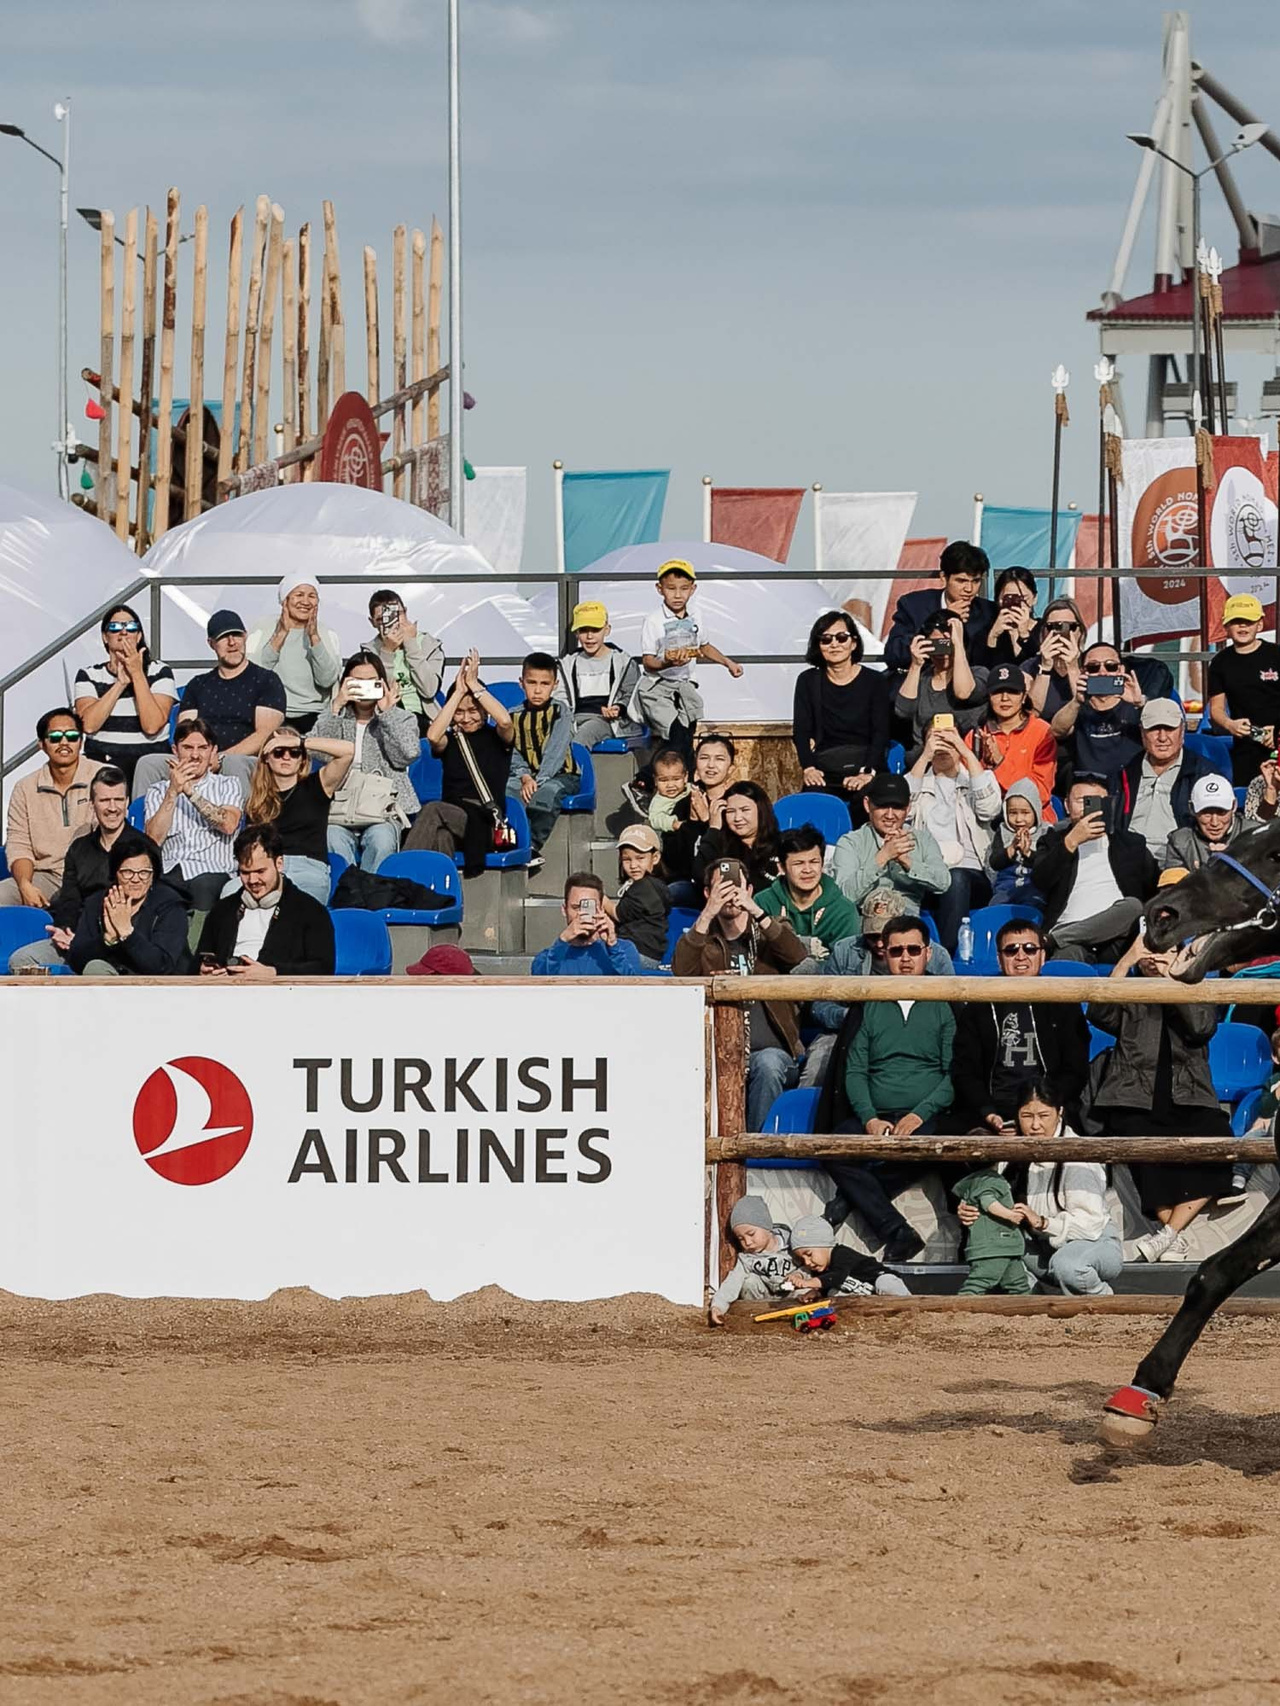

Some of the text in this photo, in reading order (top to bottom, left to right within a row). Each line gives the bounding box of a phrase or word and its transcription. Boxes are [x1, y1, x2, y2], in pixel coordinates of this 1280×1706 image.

[1148, 497, 1174, 538] WORLD
[1163, 579, 1186, 589] 2024
[292, 1056, 608, 1113] TURKISH
[287, 1127, 612, 1184] AIRLINES
